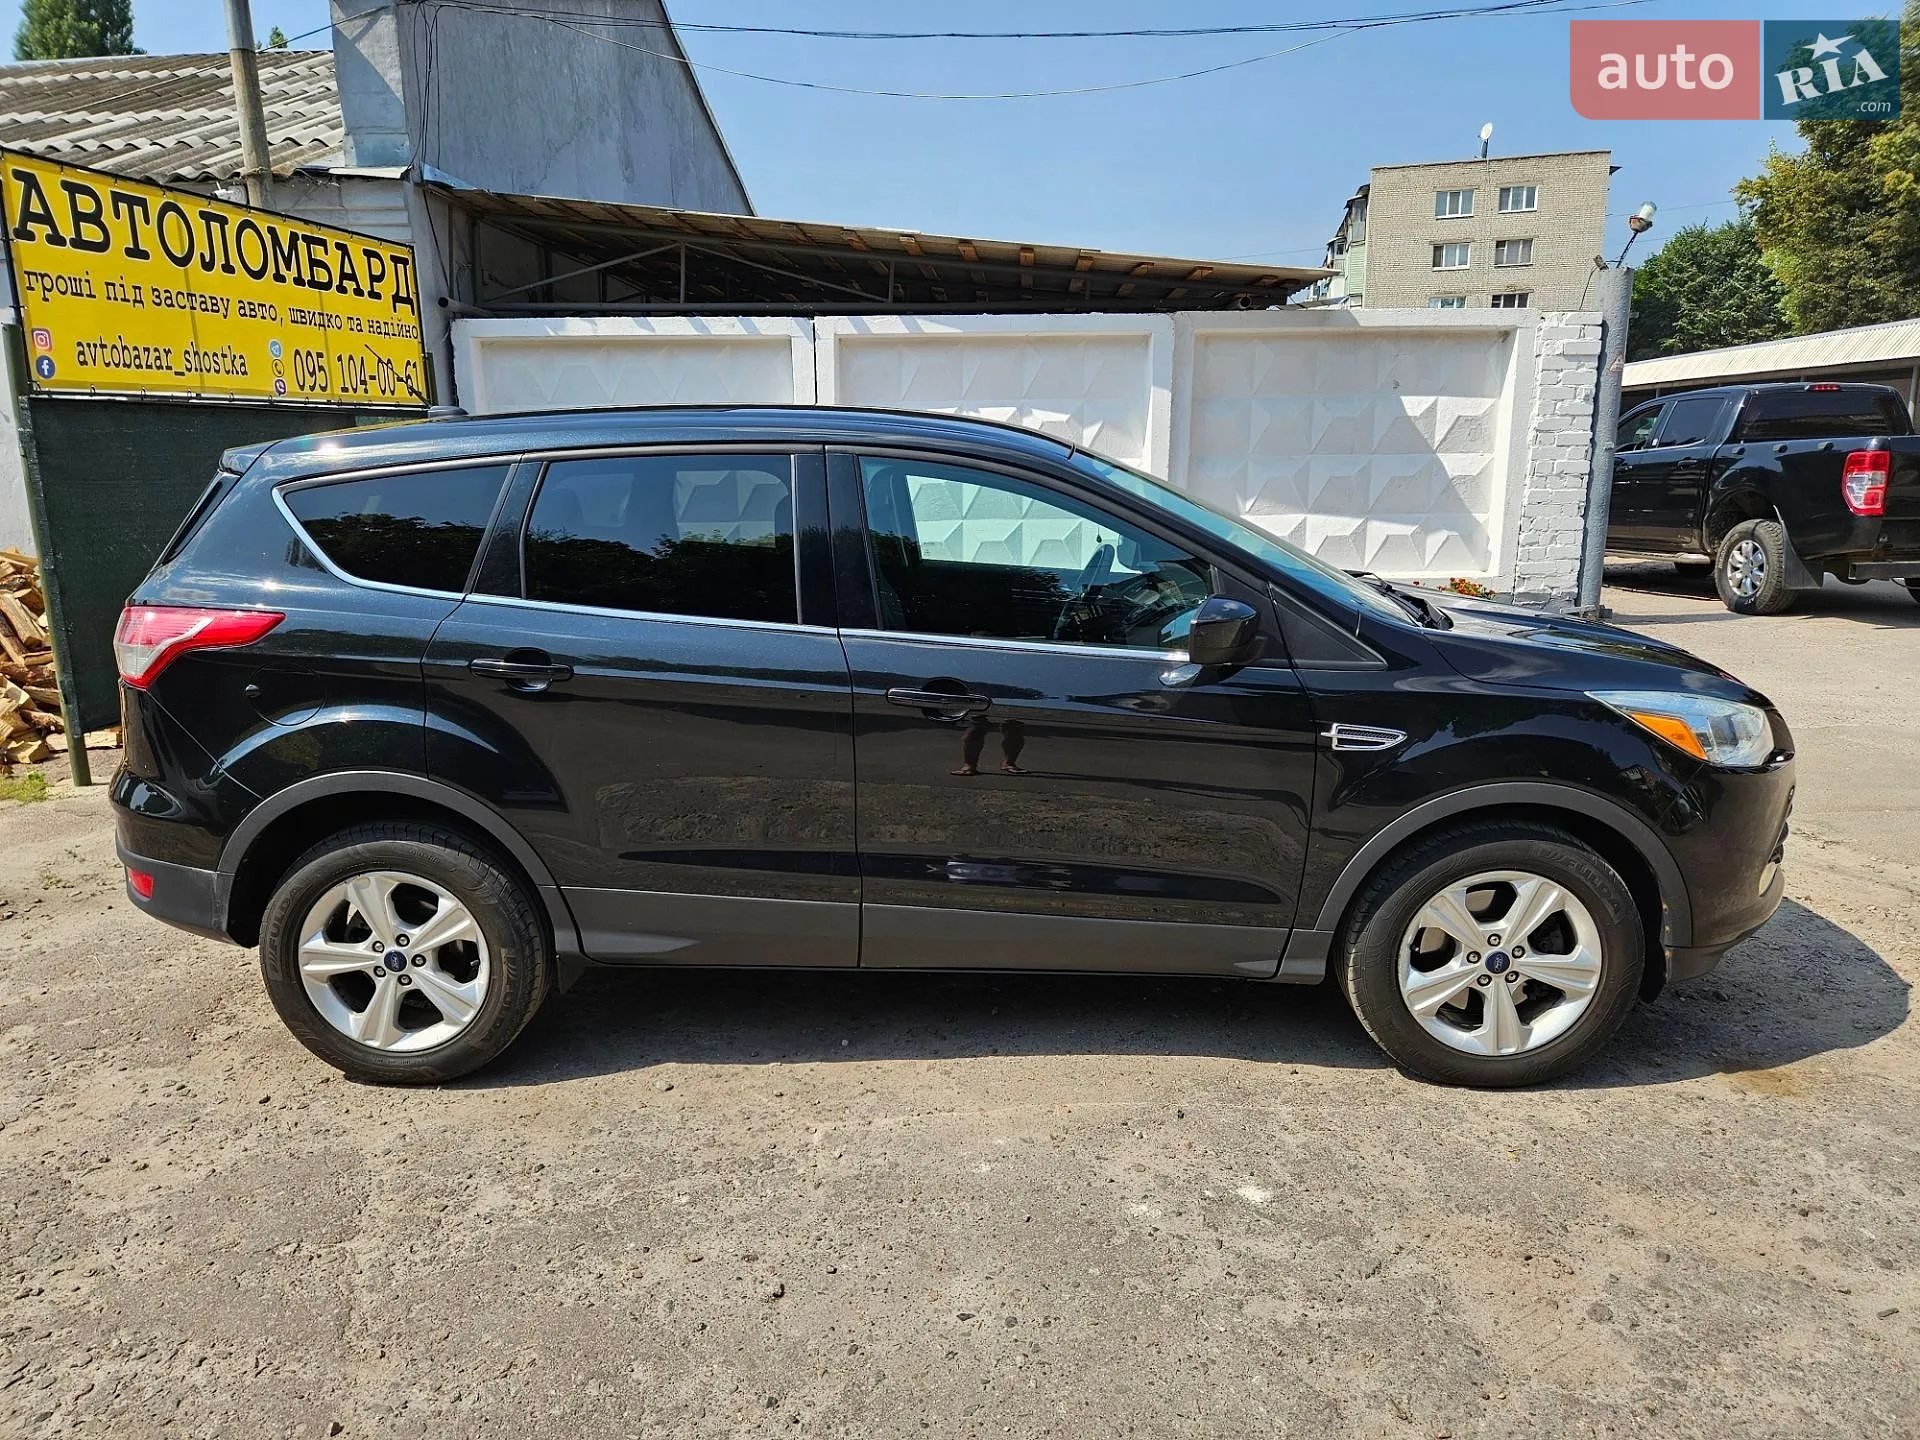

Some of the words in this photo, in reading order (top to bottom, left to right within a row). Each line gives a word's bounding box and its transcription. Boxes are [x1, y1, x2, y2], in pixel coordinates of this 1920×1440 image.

[11, 168, 416, 316] АВТОЛОМБАРД
[24, 271, 97, 302] гроші
[104, 276, 145, 309] під
[151, 285, 230, 319] заставу
[237, 299, 284, 327] авто,
[287, 307, 343, 333] швидко
[346, 315, 364, 333] та
[367, 317, 419, 341] надійно
[76, 335, 249, 377] avtobazar_shostka
[293, 349, 329, 393] 095
[336, 353, 420, 397] 104-00-61
